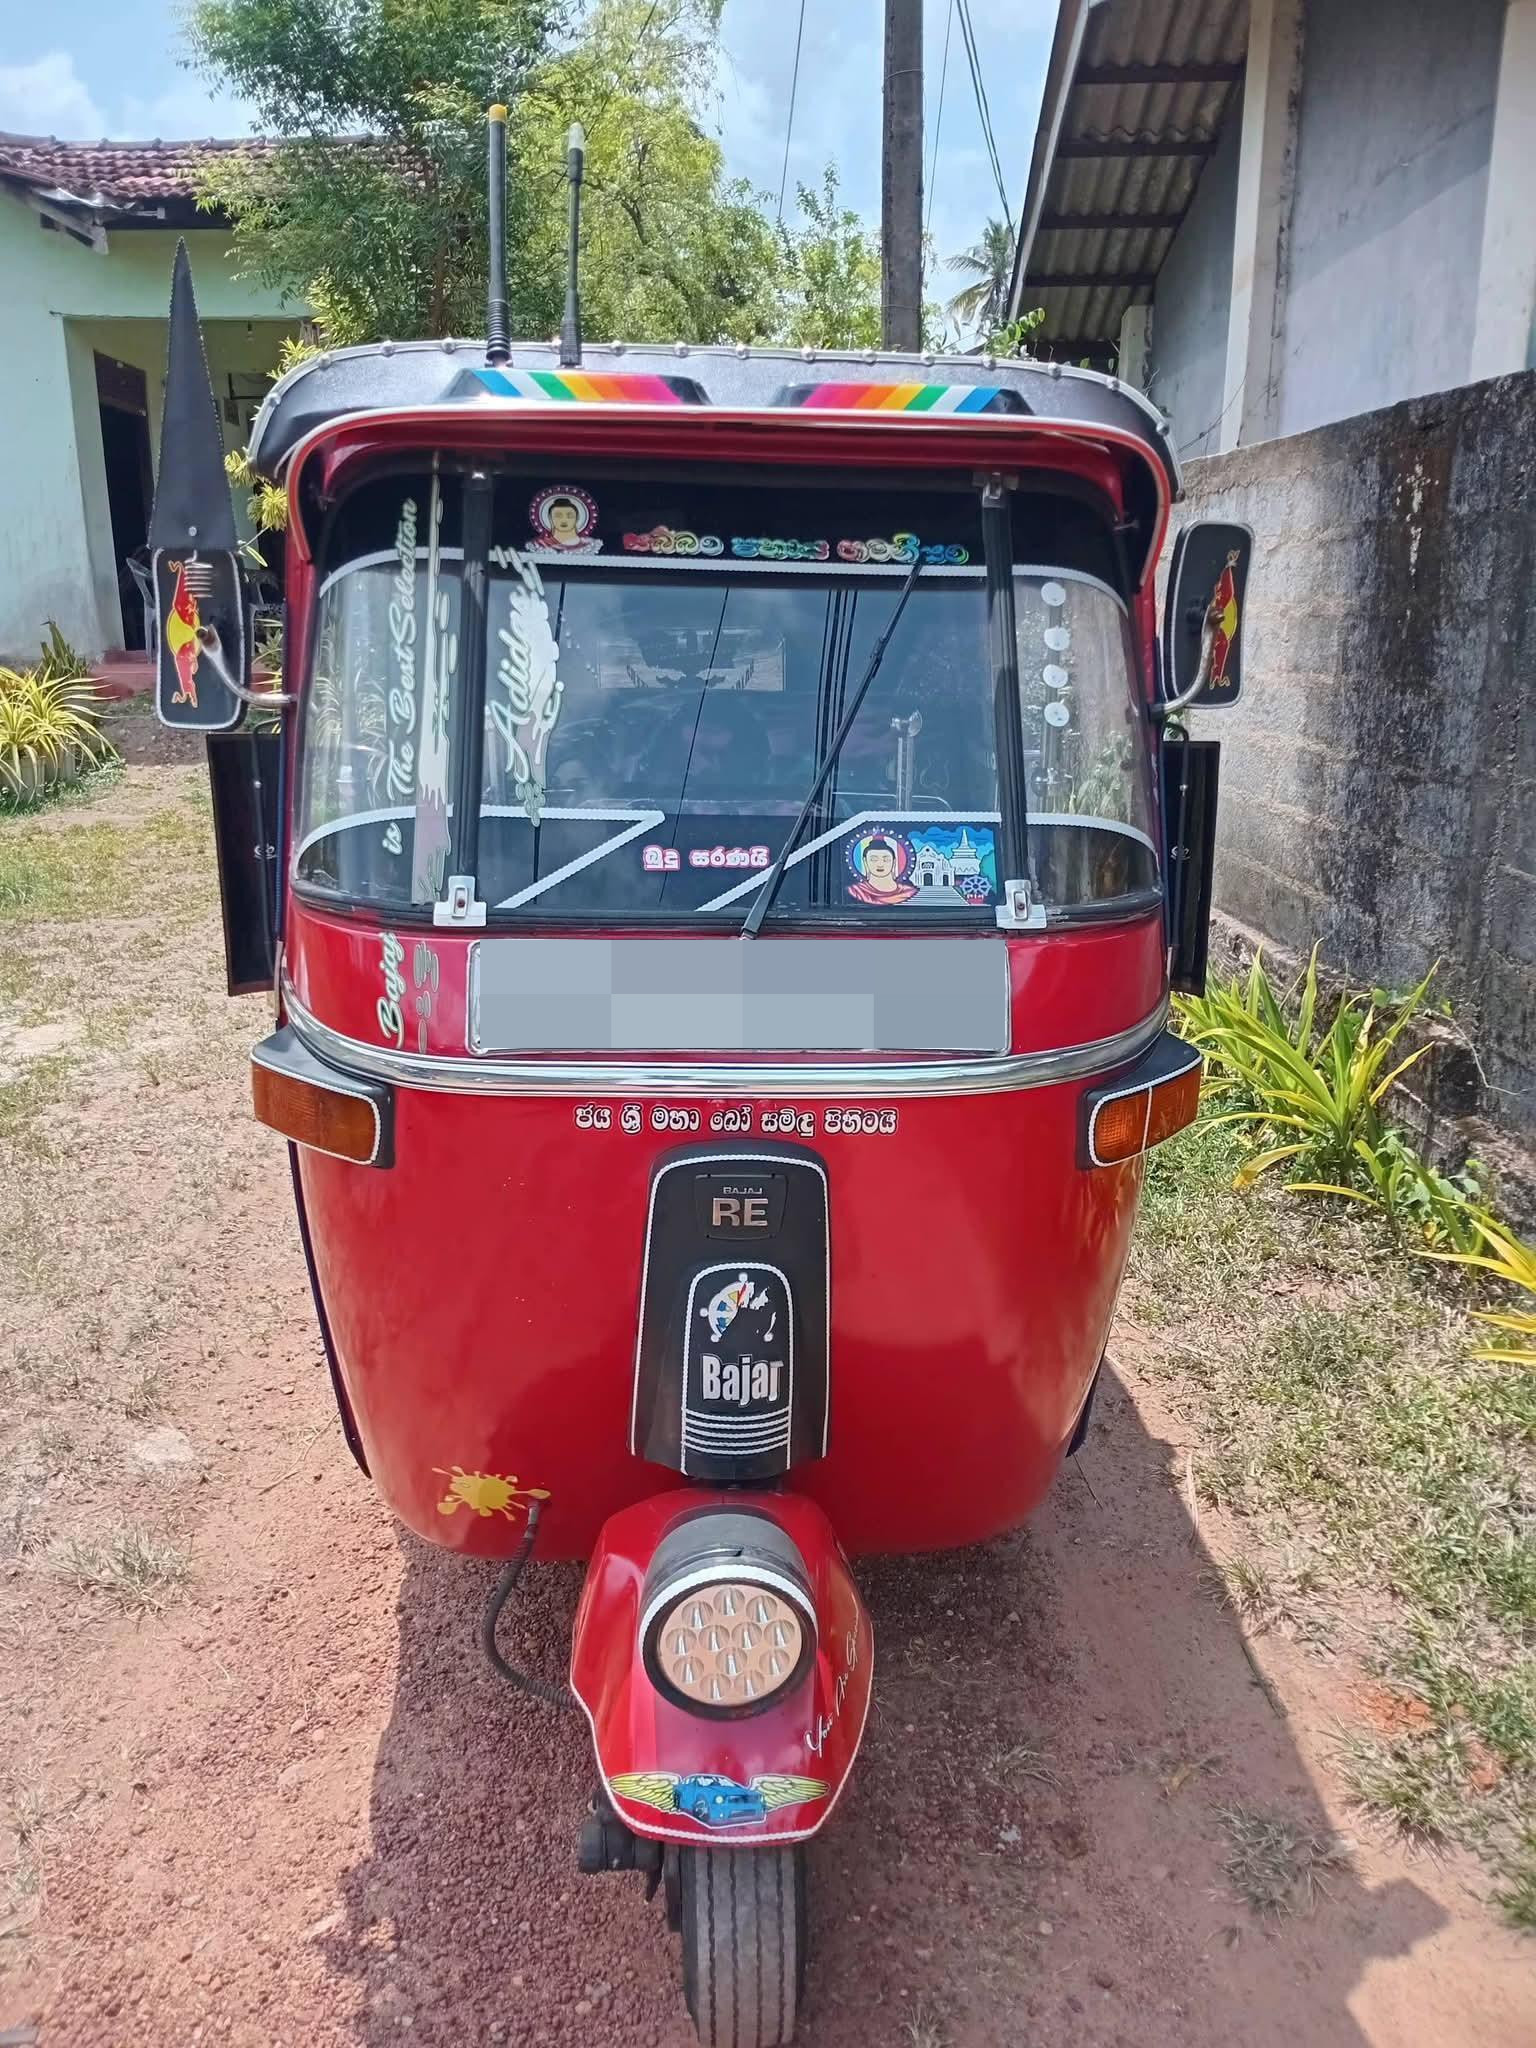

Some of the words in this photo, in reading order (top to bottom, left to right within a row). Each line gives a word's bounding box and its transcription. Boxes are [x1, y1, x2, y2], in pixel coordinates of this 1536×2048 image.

[386, 738, 415, 801] The
[382, 821, 403, 855] is
[690, 846, 769, 868] සරණයි
[575, 1104, 611, 1130] ජය
[650, 1105, 700, 1131] මහා
[723, 1187, 763, 1195] BAJAJ
[712, 1197, 769, 1226] RE
